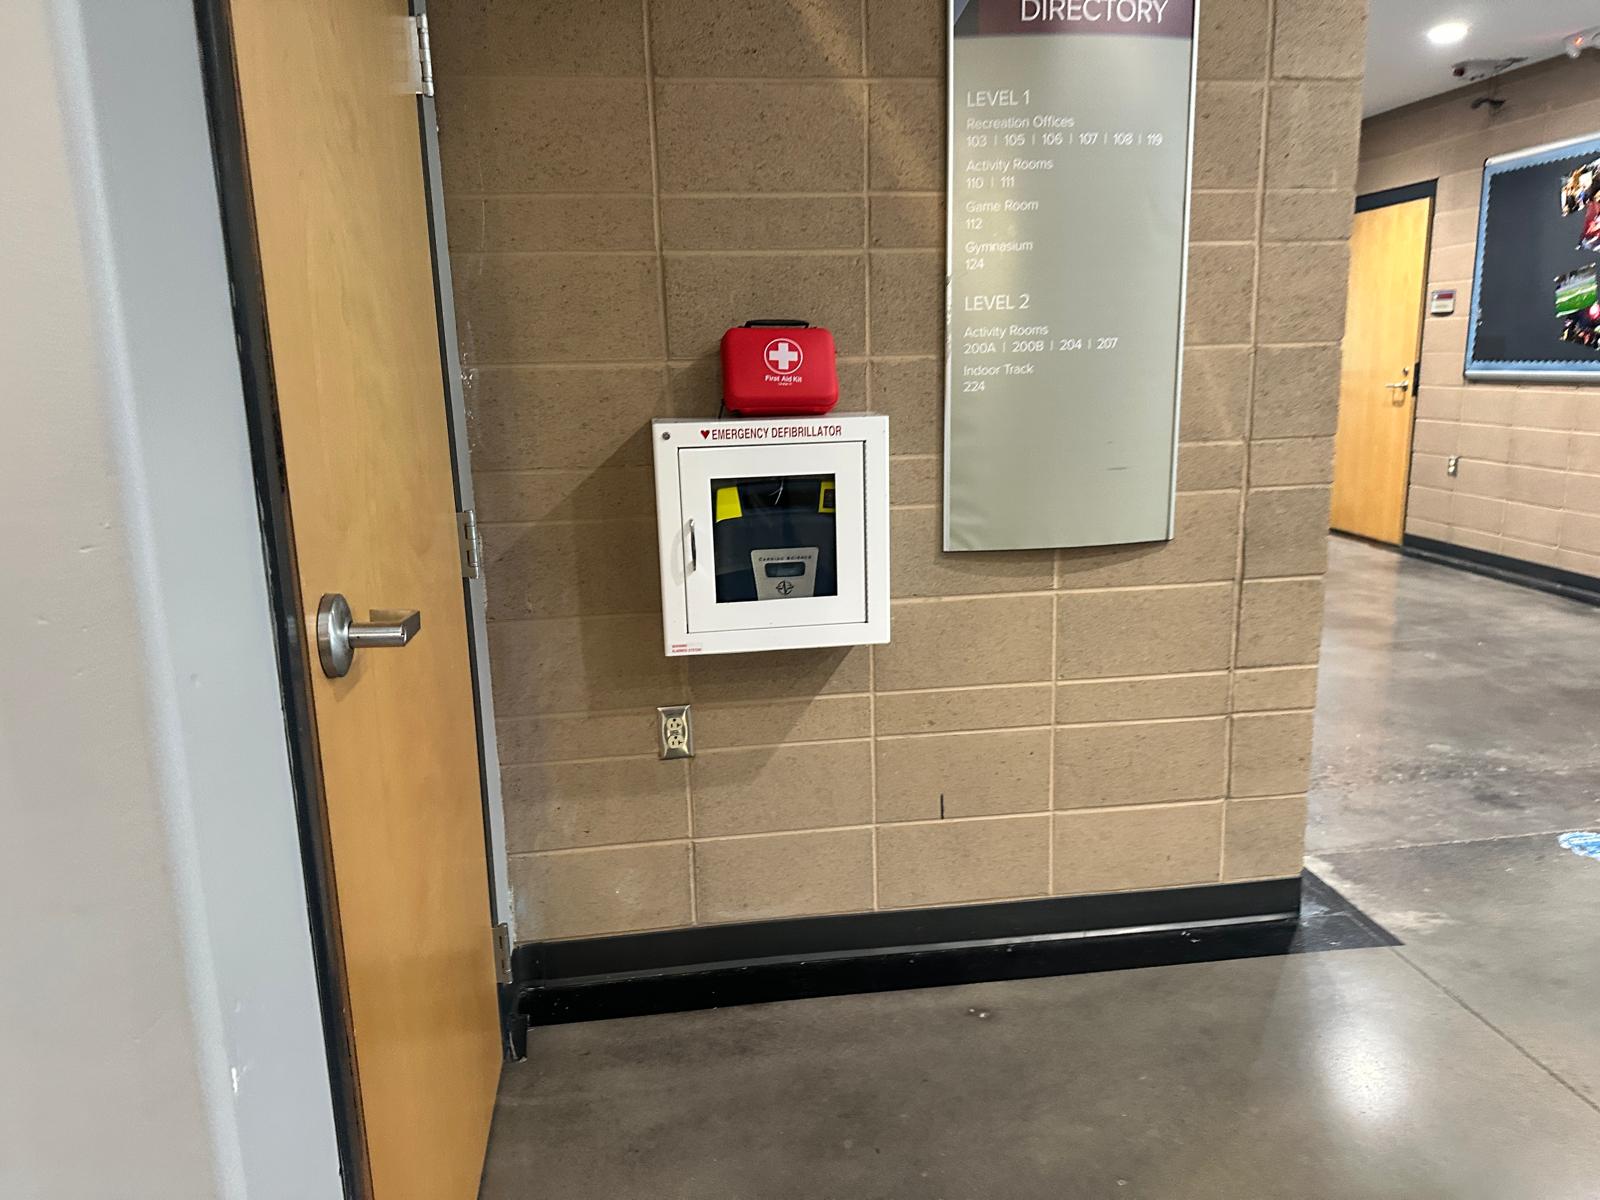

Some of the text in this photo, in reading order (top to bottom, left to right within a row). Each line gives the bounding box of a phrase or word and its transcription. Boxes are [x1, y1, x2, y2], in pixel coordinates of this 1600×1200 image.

[1020, 0, 1168, 23] DIRECTORY
[966, 88, 1031, 108] LEVEL 1
[966, 115, 1075, 130] Recreation Offices
[966, 134, 988, 147] 103
[1004, 133, 1026, 146] 105
[1041, 132, 1064, 146] 106
[1079, 131, 1099, 145] 107
[966, 158, 1054, 174] Activity Rooms
[966, 176, 984, 189] 110
[1000, 175, 1016, 188] 111
[966, 199, 1040, 213] Game Room
[966, 218, 983, 229] 112
[965, 240, 1034, 255] Gymnasium
[966, 258, 985, 270] 124
[964, 293, 1031, 311] LEVEL 2
[962, 324, 1049, 340] Activity Rooms
[962, 341, 997, 355] 200A
[1011, 340, 1045, 353] 200B
[1059, 338, 1082, 351] 204
[1096, 336, 1119, 349] 207
[962, 363, 1035, 376] Indoor Track
[764, 374, 803, 383] First Aid Kit
[962, 380, 985, 393] 224
[711, 425, 842, 441] EMERGENCY DEFIBRILLATOR
